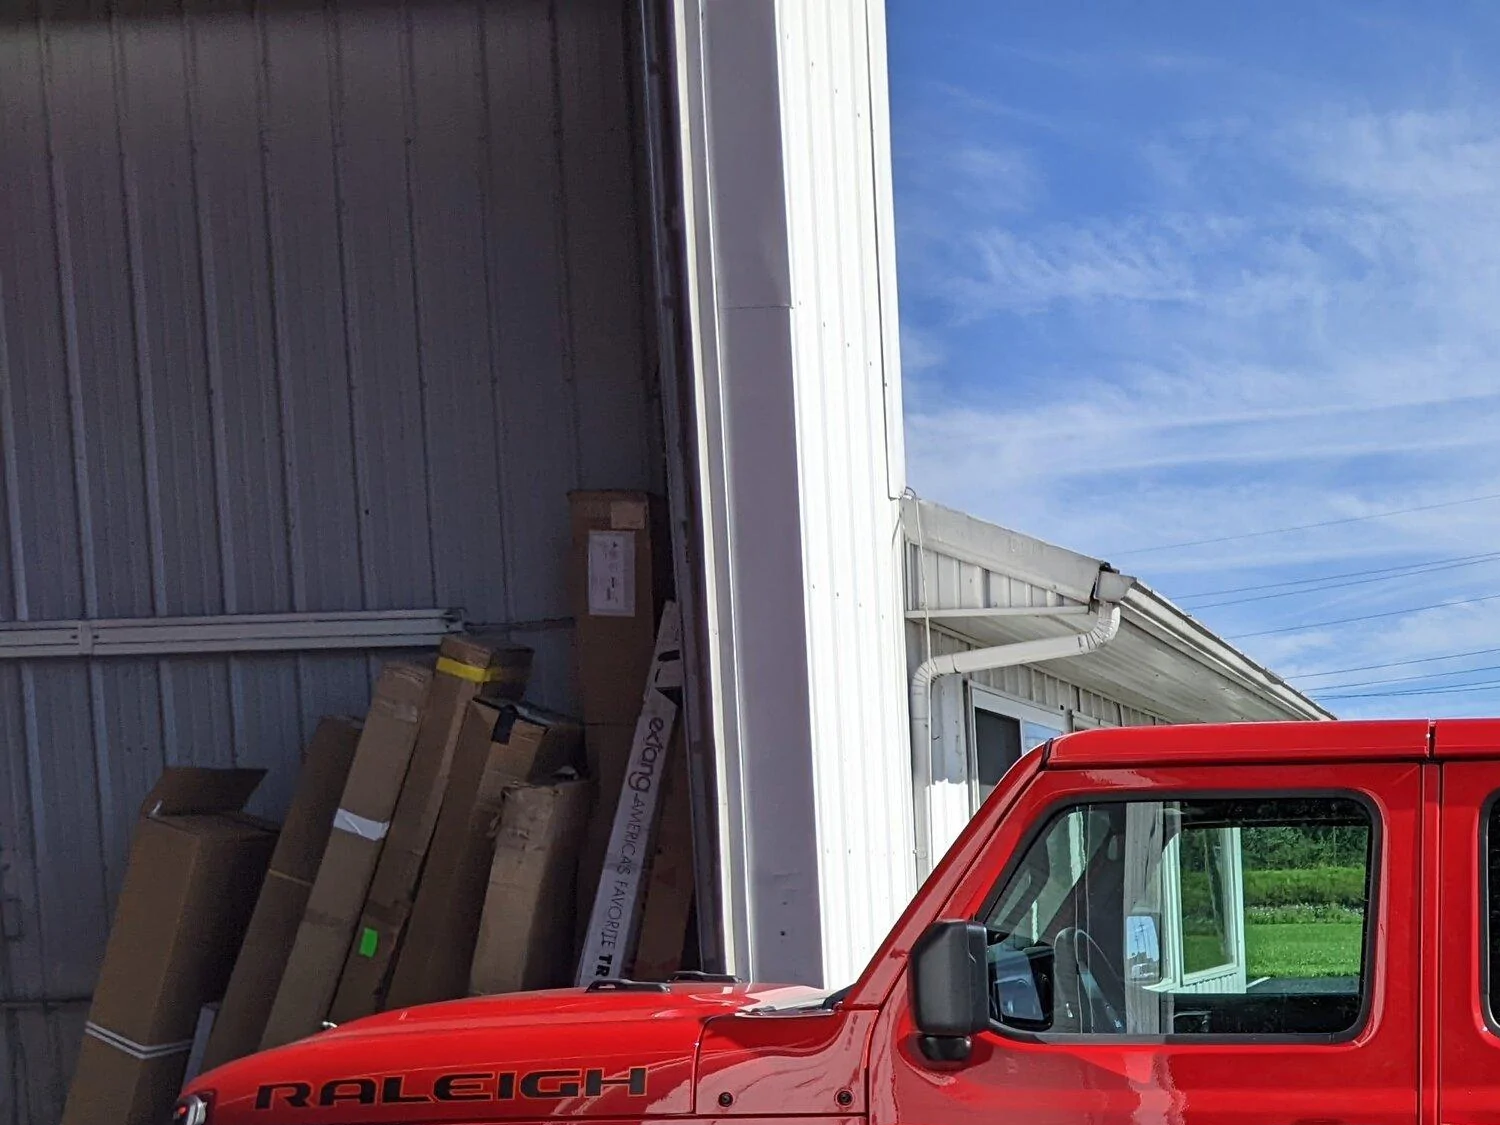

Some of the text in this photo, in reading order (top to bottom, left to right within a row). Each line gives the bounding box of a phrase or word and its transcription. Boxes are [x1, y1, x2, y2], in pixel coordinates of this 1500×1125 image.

[629, 717, 665, 793] extang
[600, 879, 629, 951] FAVORITE
[255, 1067, 648, 1110] RALEIGH
